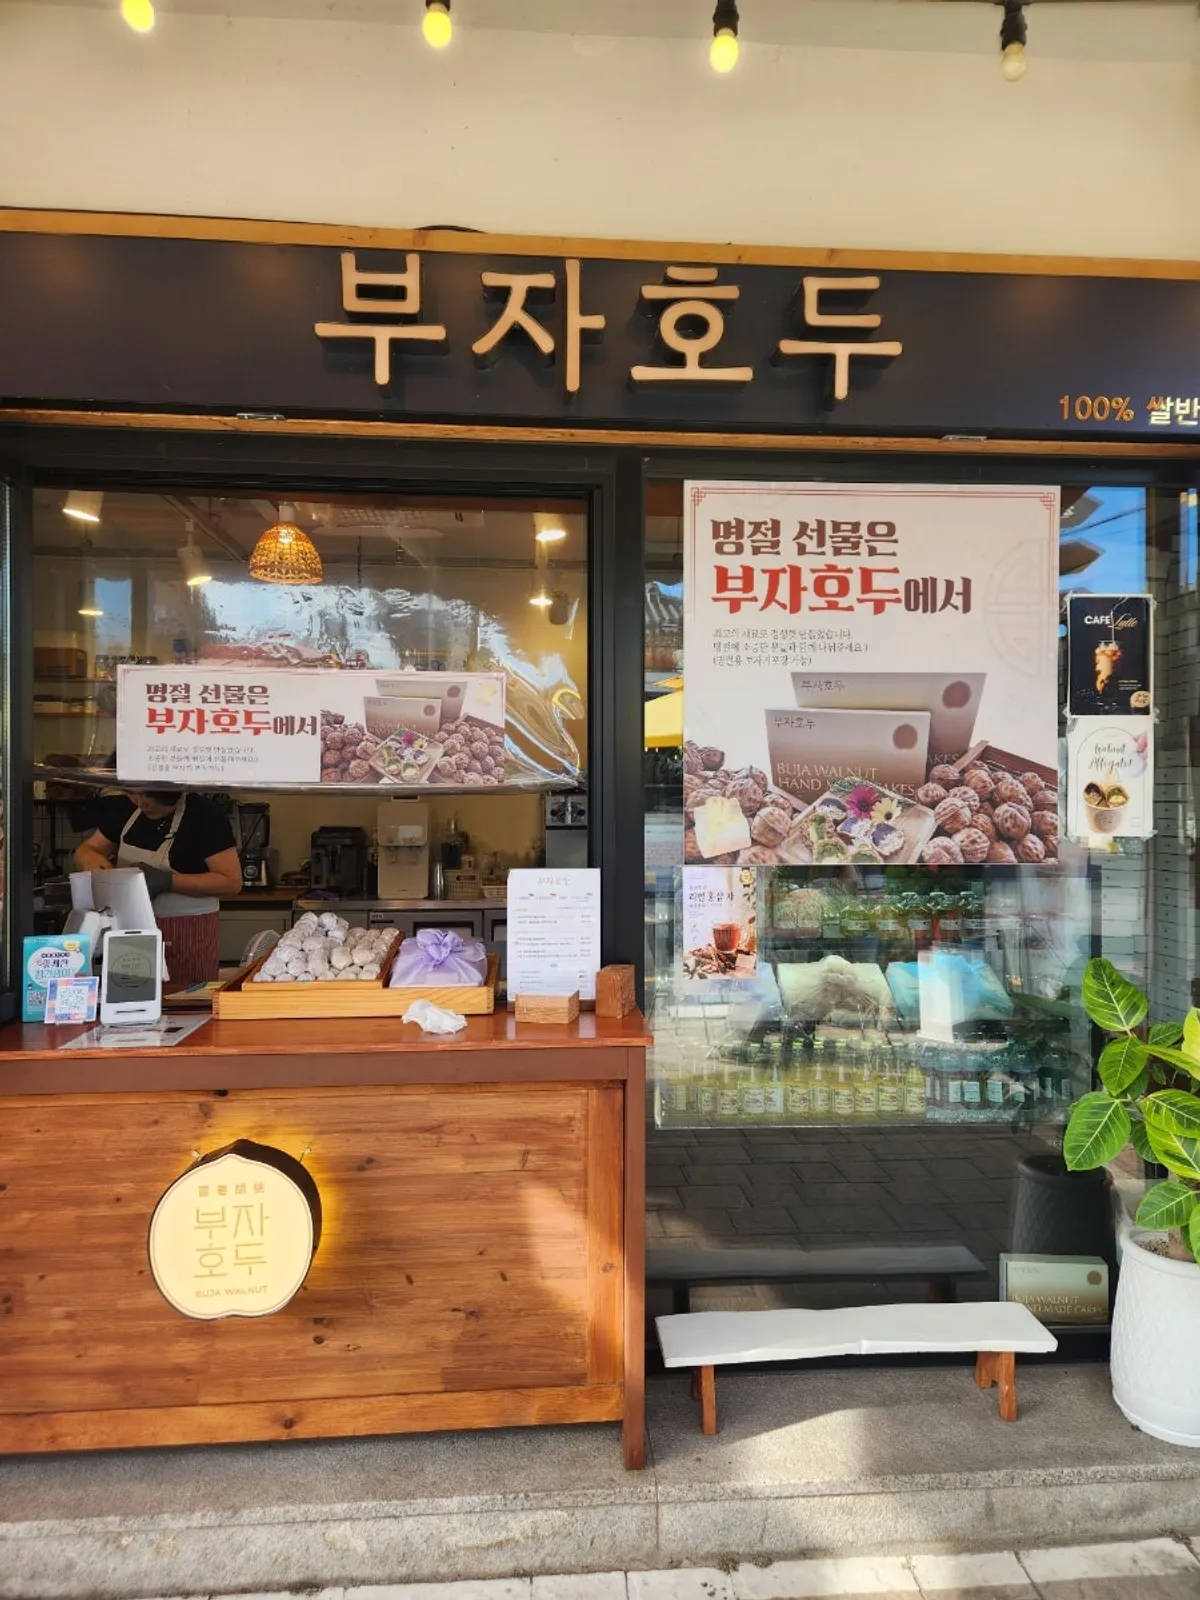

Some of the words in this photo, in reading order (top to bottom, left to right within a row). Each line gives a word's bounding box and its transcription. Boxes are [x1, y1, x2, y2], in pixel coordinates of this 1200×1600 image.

[314, 251, 903, 400] 부자호두
[1060, 394, 1135, 421] 100%
[711, 517, 781, 556] 명절
[792, 518, 899, 557] 선물은
[711, 563, 972, 615] 부자호두에서
[1084, 615, 1111, 625] CAFE
[145, 682, 191, 704] 명절
[199, 684, 270, 705] 선물은
[146, 707, 316, 735] 부자호두에서
[777, 762, 811, 778] BUJA
[813, 764, 878, 780] WALNUT
[778, 777, 822, 791] HAND
[194, 1203, 271, 1239] 부자
[193, 1242, 268, 1278] 호두
[225, 1285, 269, 1296] WALNUT
